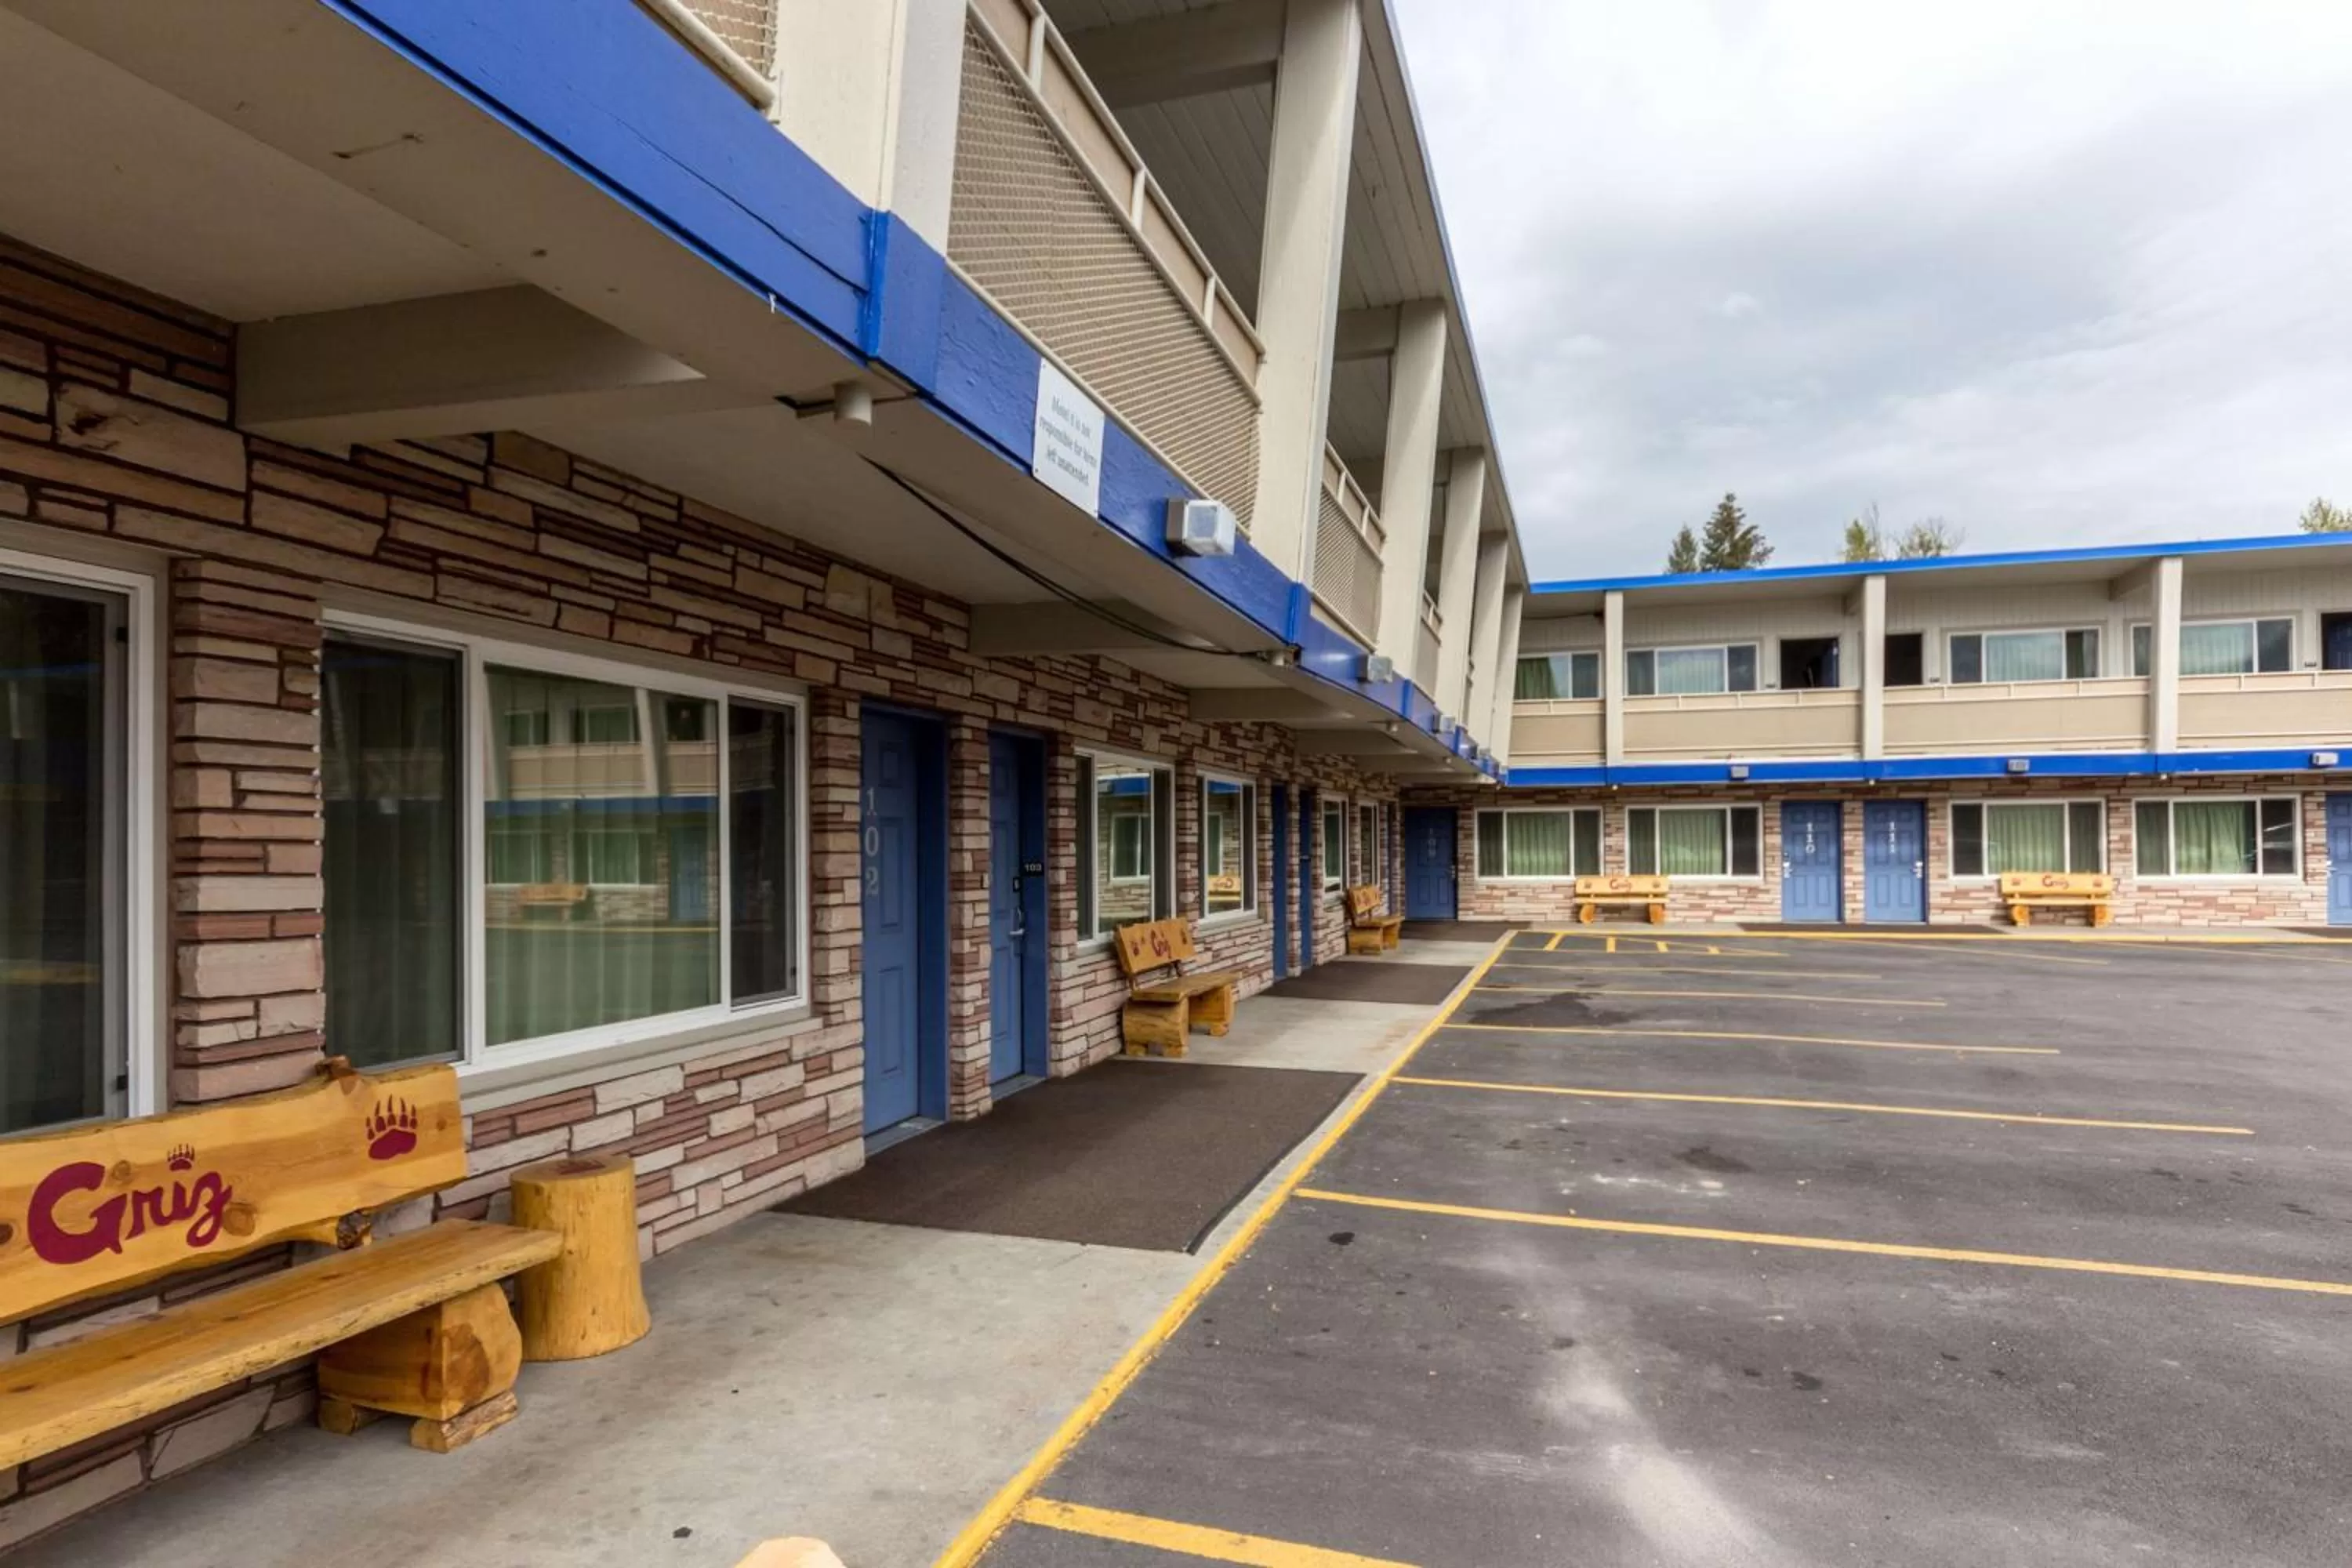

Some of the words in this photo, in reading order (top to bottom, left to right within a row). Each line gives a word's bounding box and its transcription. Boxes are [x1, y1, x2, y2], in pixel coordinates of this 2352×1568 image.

[865, 786, 879, 895] 102
[1806, 822, 1816, 854] 110
[27, 1160, 233, 1265] Griz
